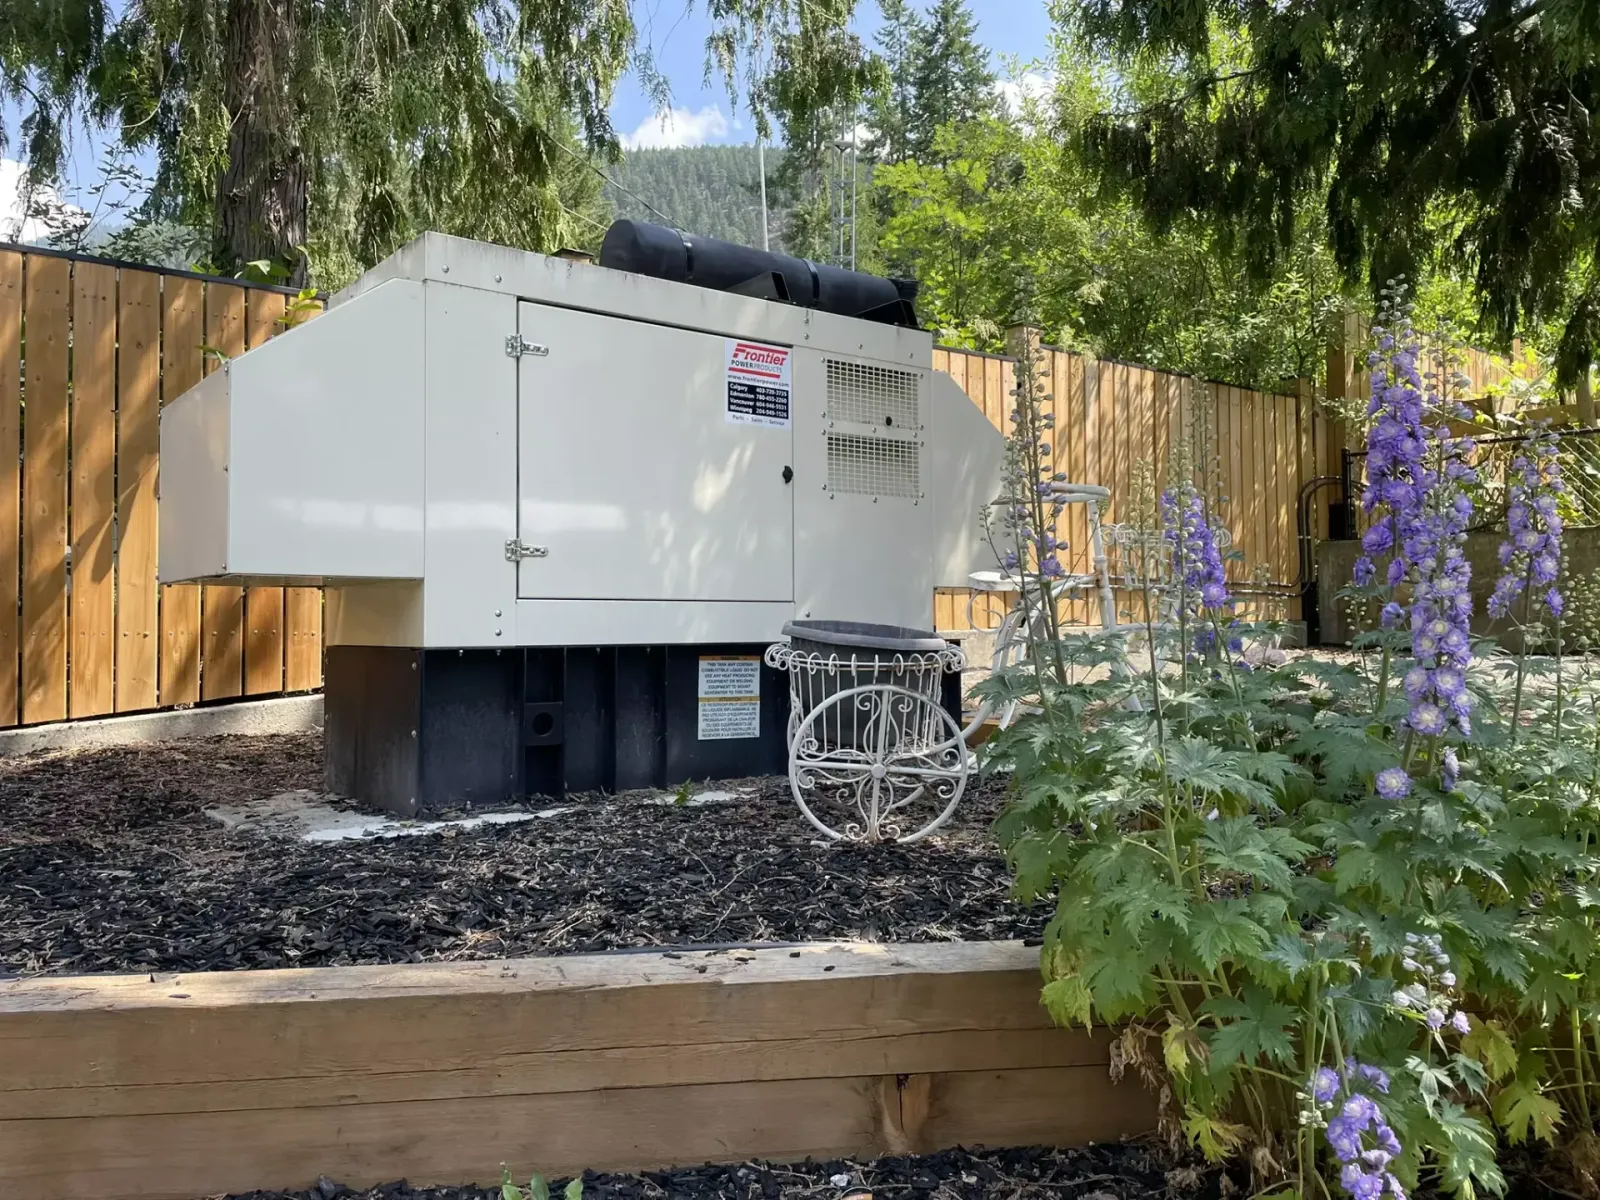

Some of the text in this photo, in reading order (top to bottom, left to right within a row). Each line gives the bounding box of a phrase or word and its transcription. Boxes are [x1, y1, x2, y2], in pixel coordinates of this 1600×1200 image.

[732, 343, 786, 366] Frontier
[730, 383, 748, 392] Calgary
[730, 390, 754, 399] Edmonton
[730, 405, 753, 414] Winnipeg
